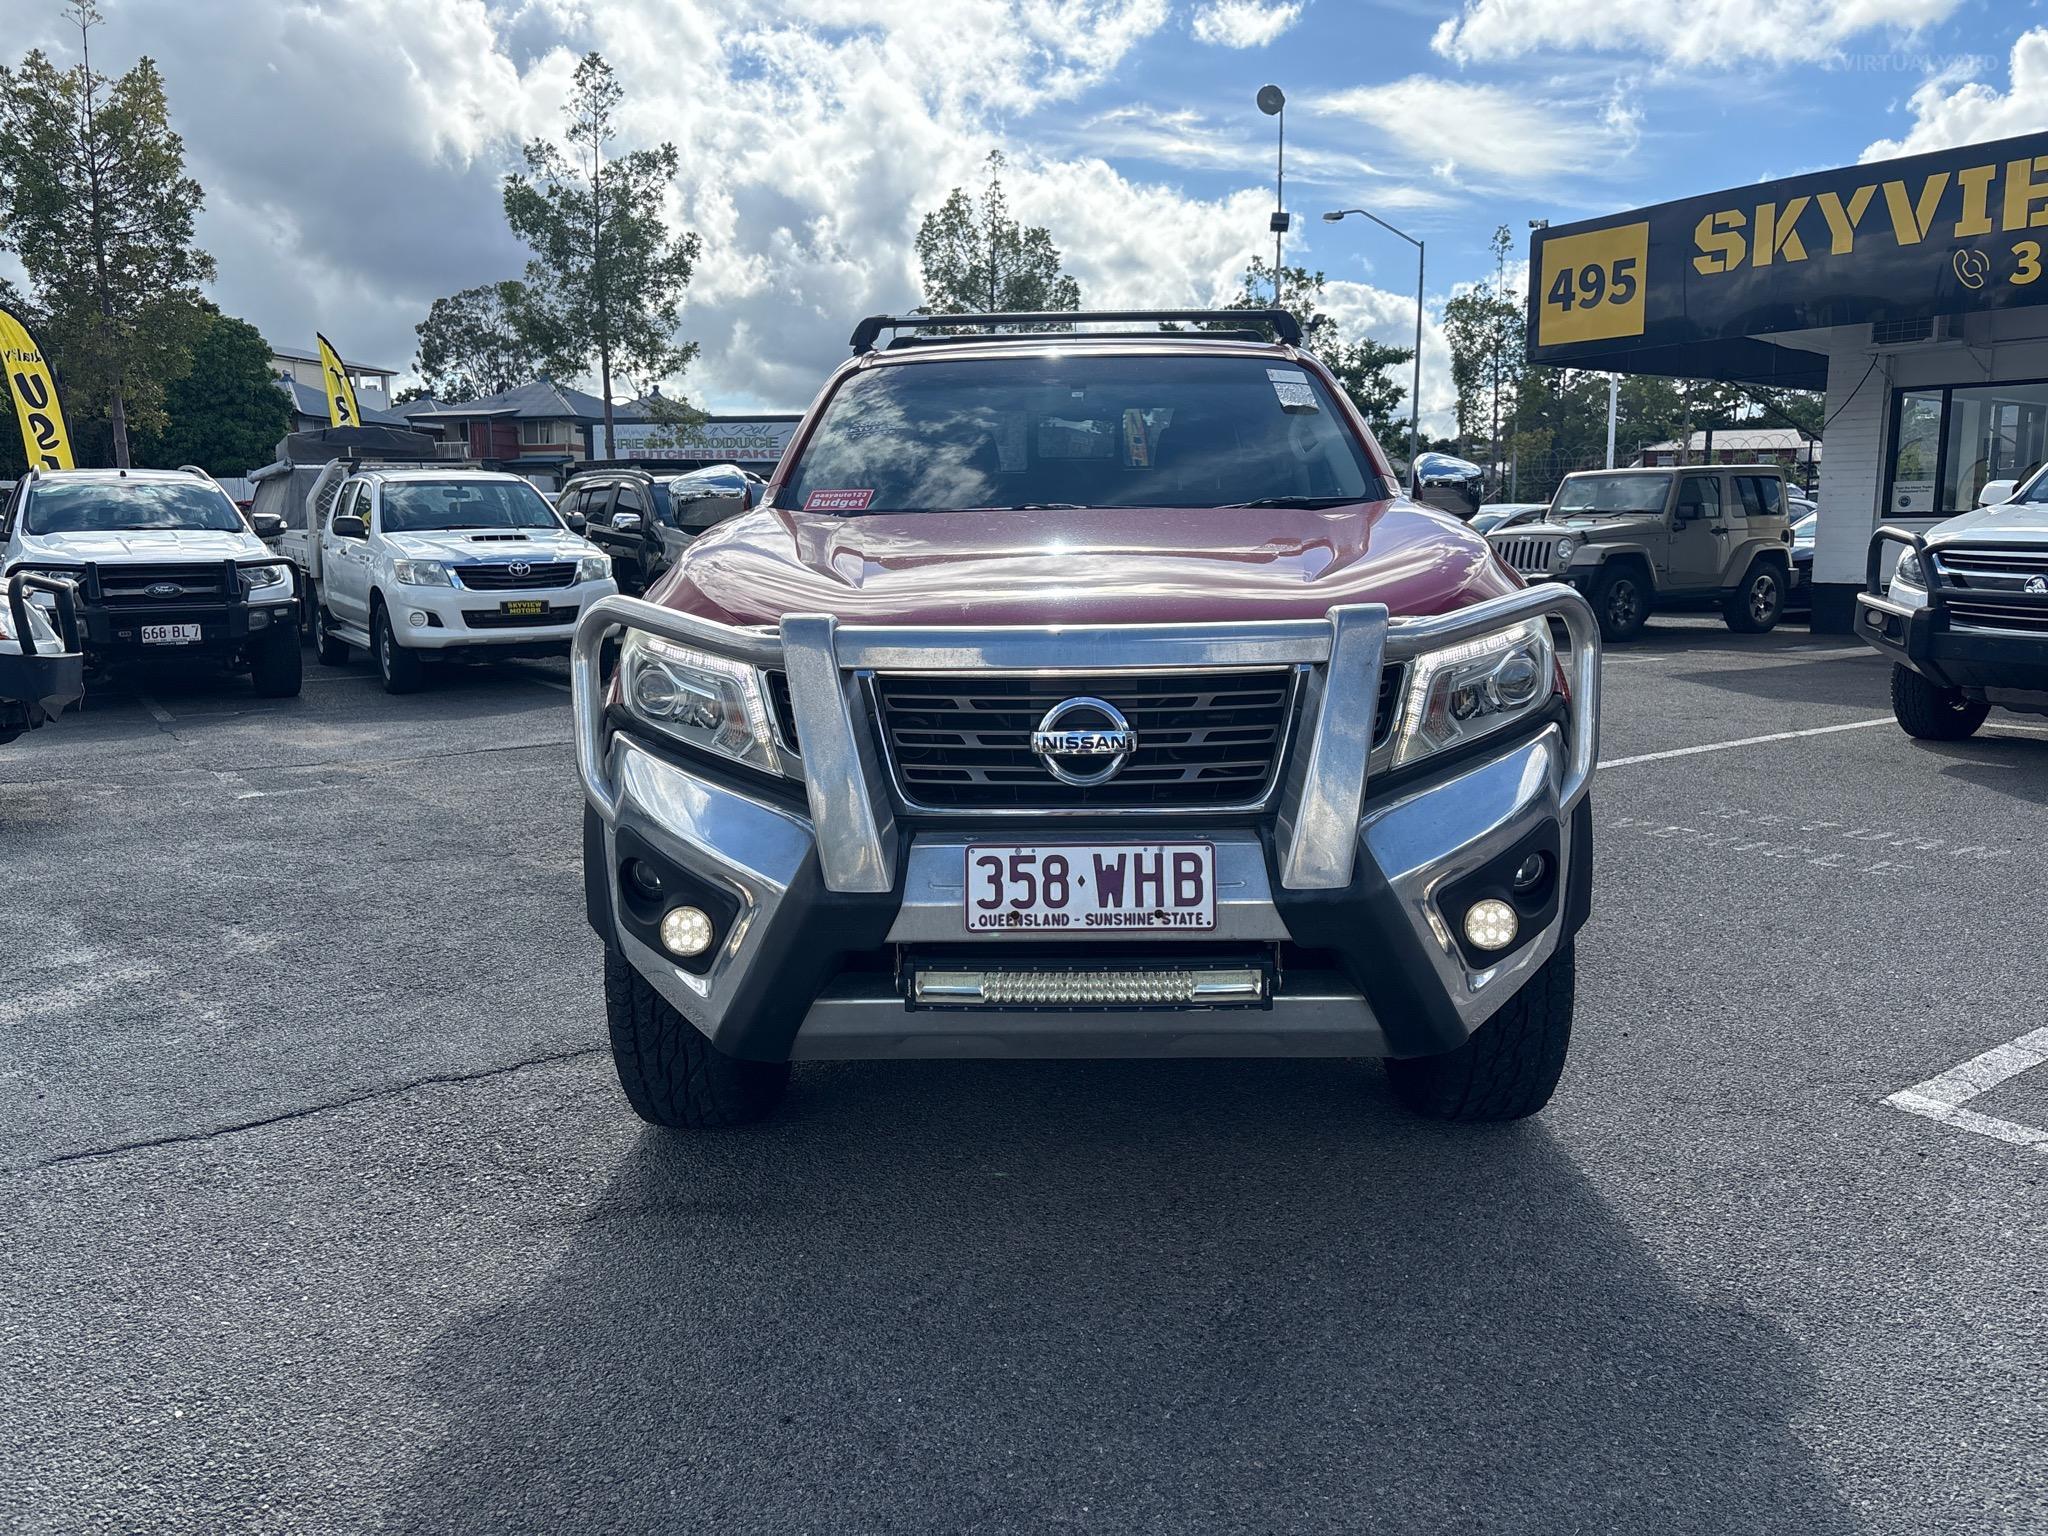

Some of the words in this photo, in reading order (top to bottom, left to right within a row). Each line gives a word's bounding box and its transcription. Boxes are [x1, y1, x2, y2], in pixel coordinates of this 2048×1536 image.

[2009, 241, 2042, 285] 3
[1548, 257, 1637, 312] 495
[678, 436, 779, 449] PRODUCE
[629, 450, 713, 460] BUTCHER
[725, 449, 785, 459] BAKE
[810, 498, 864, 508] Budget
[507, 601, 542, 609] SKYVIEW
[1042, 736, 1126, 749] NISSAN
[976, 854, 1070, 910] 358
[1092, 852, 1204, 908] WHB
[978, 913, 1070, 927] QUEENSLAND
[1085, 912, 1154, 926] SUNSHINE
[1162, 911, 1204, 925] STATE
